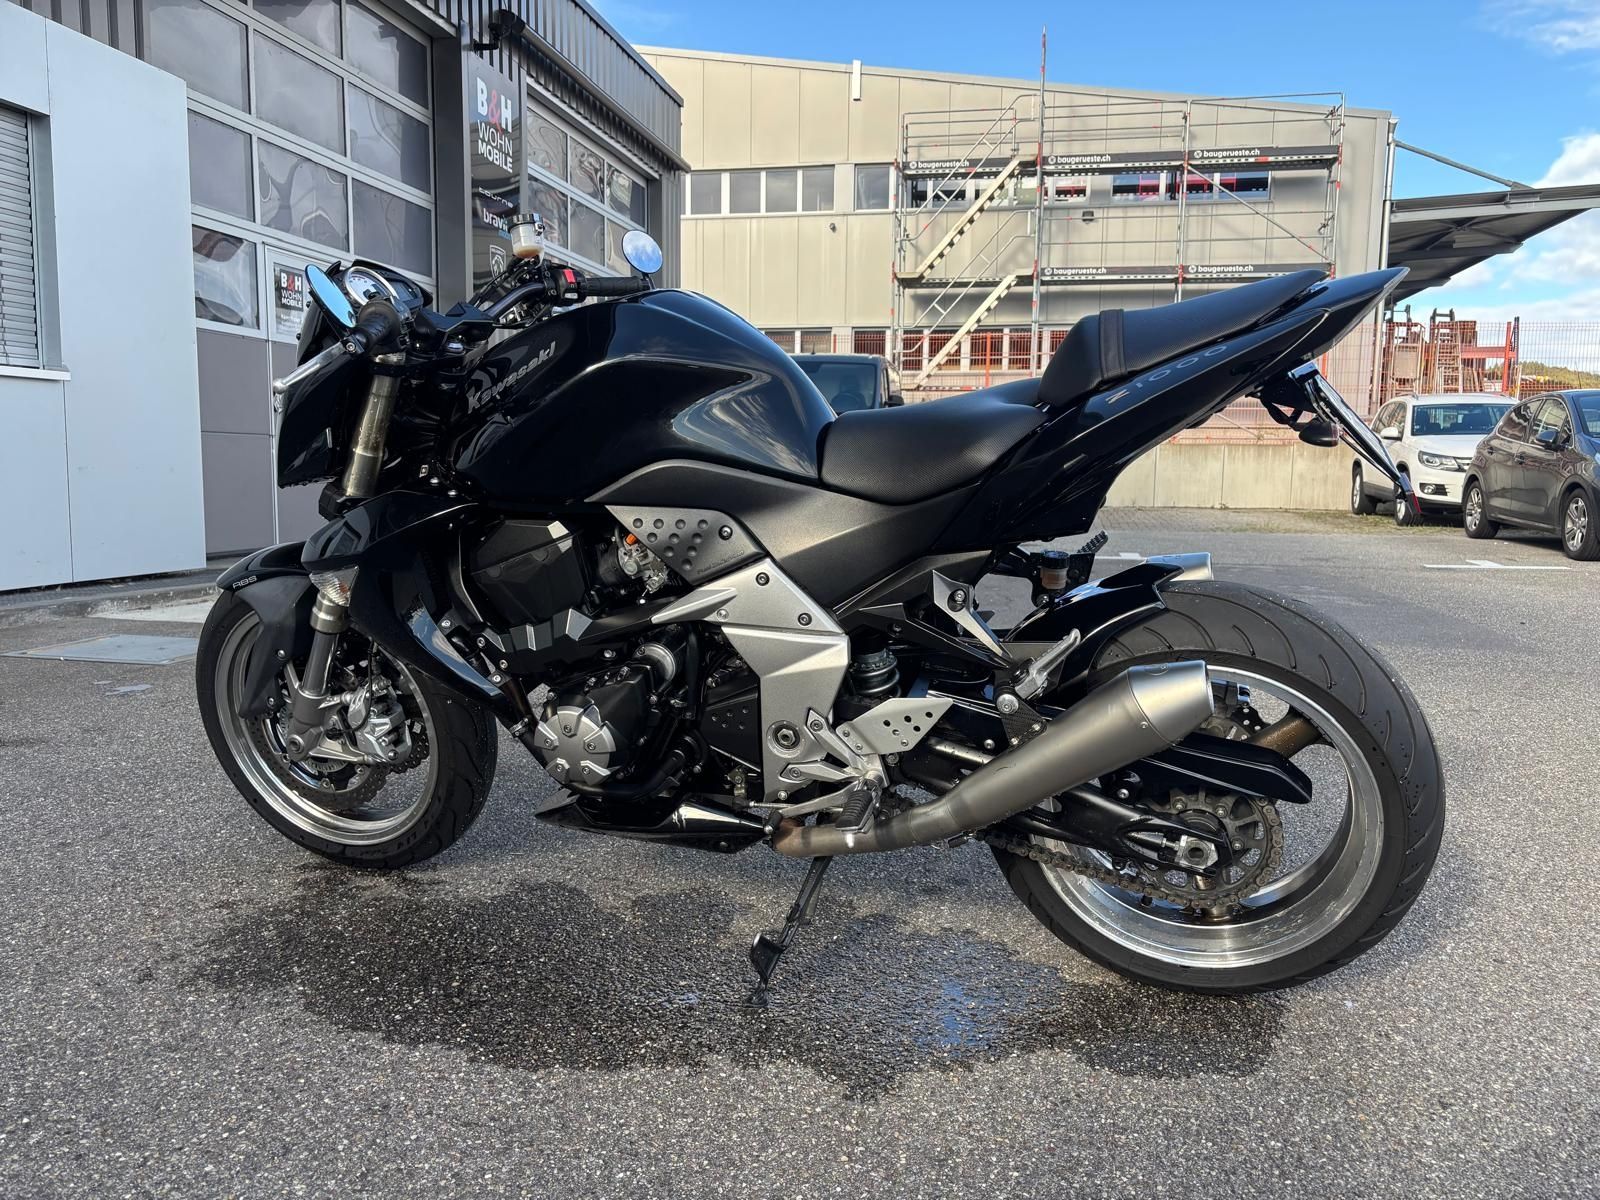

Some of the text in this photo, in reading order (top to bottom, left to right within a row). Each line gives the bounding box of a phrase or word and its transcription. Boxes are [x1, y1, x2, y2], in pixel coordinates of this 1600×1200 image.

[477, 77, 512, 133] B&H
[478, 119, 512, 156] WOHN
[478, 139, 512, 173] MOBILE
[1057, 154, 1111, 164] baugerueste.ch
[1203, 149, 1260, 158] baugerueste.ch
[1053, 267, 1107, 275] baugerueste.ch
[1197, 264, 1254, 273] baugerueste.ch
[280, 272, 302, 292] B&H
[281, 289, 302, 301] WOHN
[281, 297, 303, 308] MOBILE
[466, 340, 556, 414] Kawasaki
[232, 575, 257, 589] ABS
